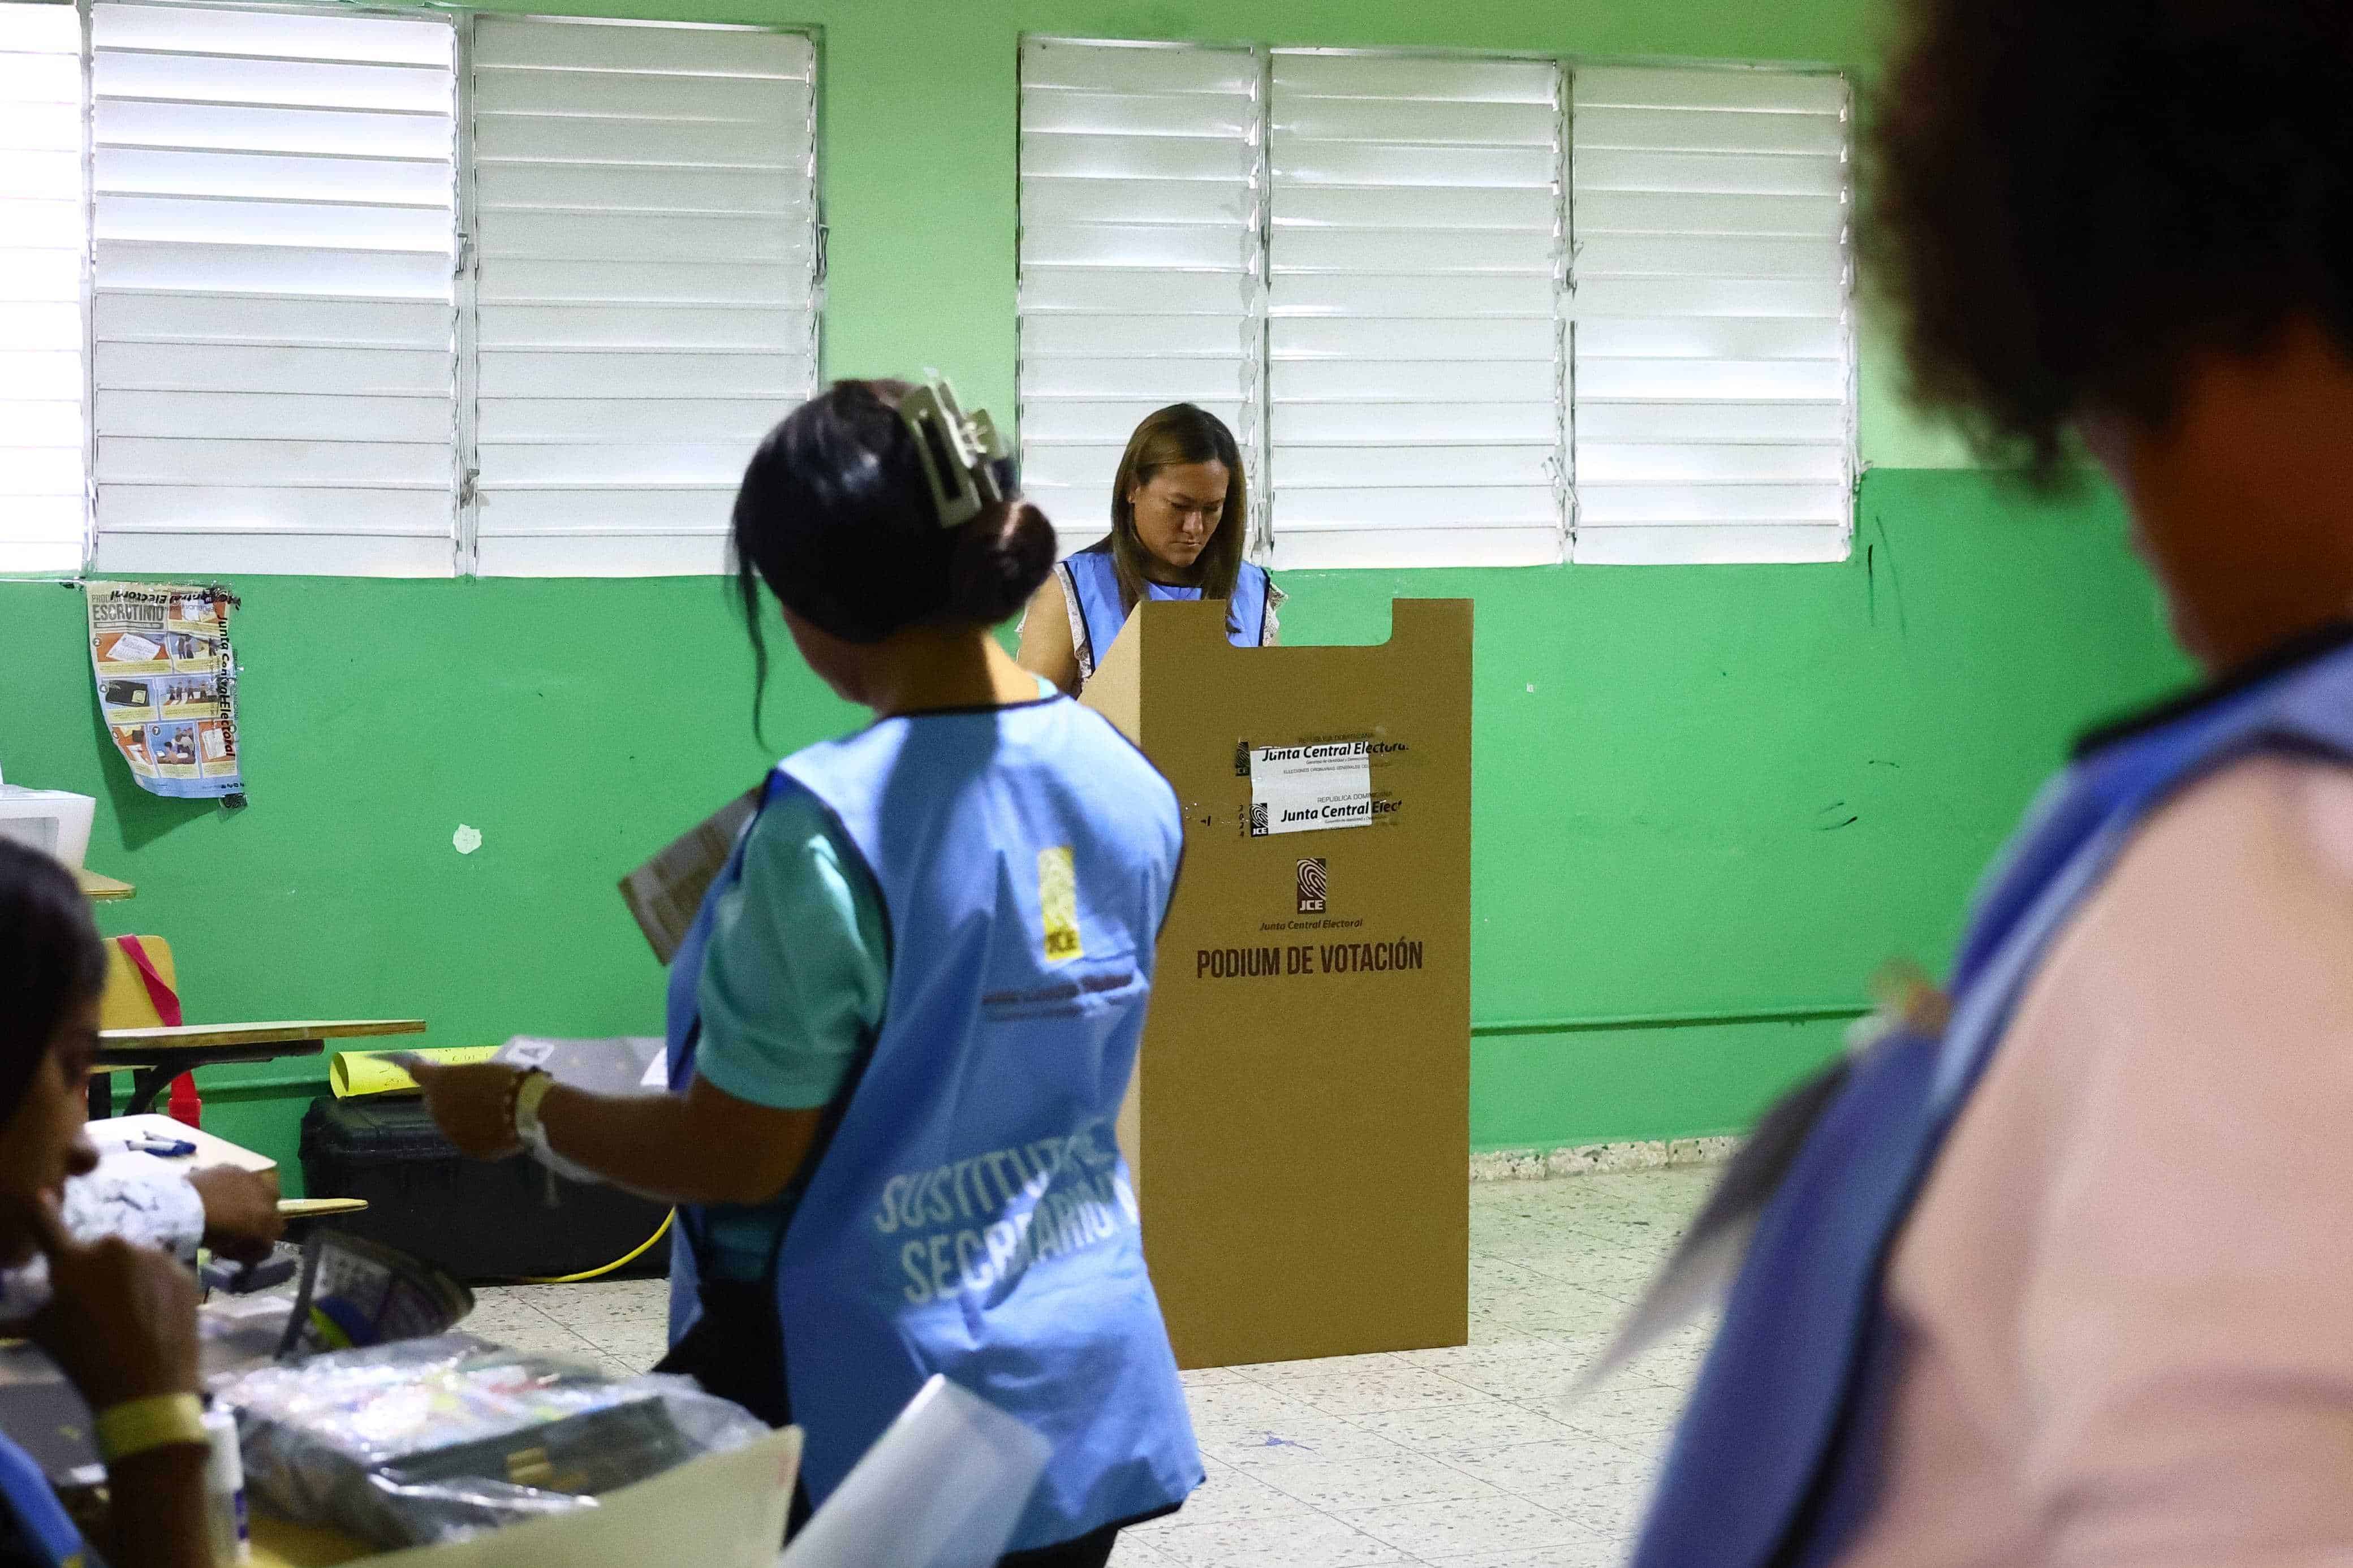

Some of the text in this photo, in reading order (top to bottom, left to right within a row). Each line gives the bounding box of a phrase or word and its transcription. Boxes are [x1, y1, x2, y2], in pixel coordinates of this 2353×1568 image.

[92, 604, 165, 621] ESCRUTINIO
[217, 616, 230, 650] Junta
[219, 701, 235, 757] Electoral
[1262, 749, 1300, 762] Junta
[1303, 744, 1351, 758] Central
[1354, 741, 1409, 755] Electora
[1281, 808, 1318, 823] Junta
[1321, 802, 1369, 818] Central
[1300, 900, 1324, 911] JCE
[1260, 918, 1363, 931] Junta Central Electoral
[1197, 936, 1424, 979] PODIUM DE VOTACIÓN
